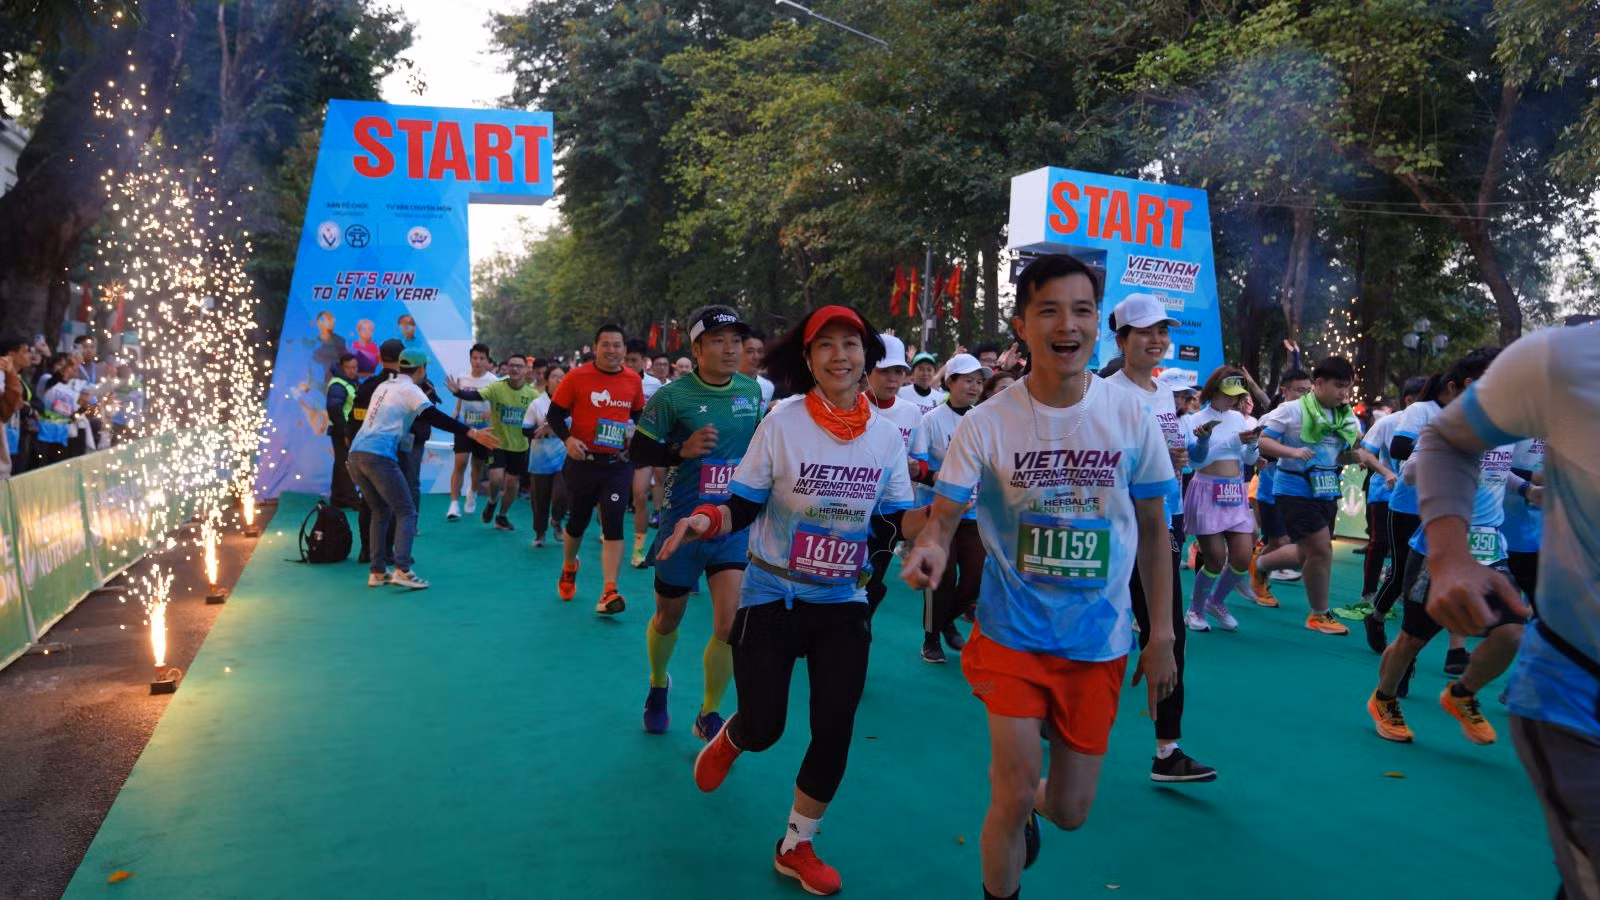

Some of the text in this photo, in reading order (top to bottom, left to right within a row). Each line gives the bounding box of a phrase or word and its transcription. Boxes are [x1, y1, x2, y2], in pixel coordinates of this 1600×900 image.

[353, 115, 548, 184] START
[1049, 181, 1193, 249] START
[1129, 255, 1200, 277] VIETNAM
[336, 272, 415, 285] LET'S RUN
[1125, 270, 1193, 285] INTERNATIONAL
[1142, 280, 1180, 289] MARATHON
[313, 287, 439, 301] TO A NEW YEAR!
[1014, 450, 1122, 470] VIETNAM
[1484, 451, 1512, 461] ETNA
[710, 466, 736, 484] 161
[800, 462, 882, 483] VIETNAM
[1012, 468, 1115, 481] INTERNATIONAL
[795, 478, 877, 493] INTERNATIONAL
[1010, 478, 1115, 489] HALF MARATHON 2023
[792, 487, 816, 496] HALF
[816, 489, 865, 499] MARATHON
[1044, 497, 1101, 507] HERBALIFE
[819, 507, 867, 517] HERBALIFE
[1043, 504, 1101, 515] NUTRITION
[818, 513, 865, 522] NUTRITION
[805, 535, 858, 564] 16192
[1030, 527, 1097, 560] 11159
